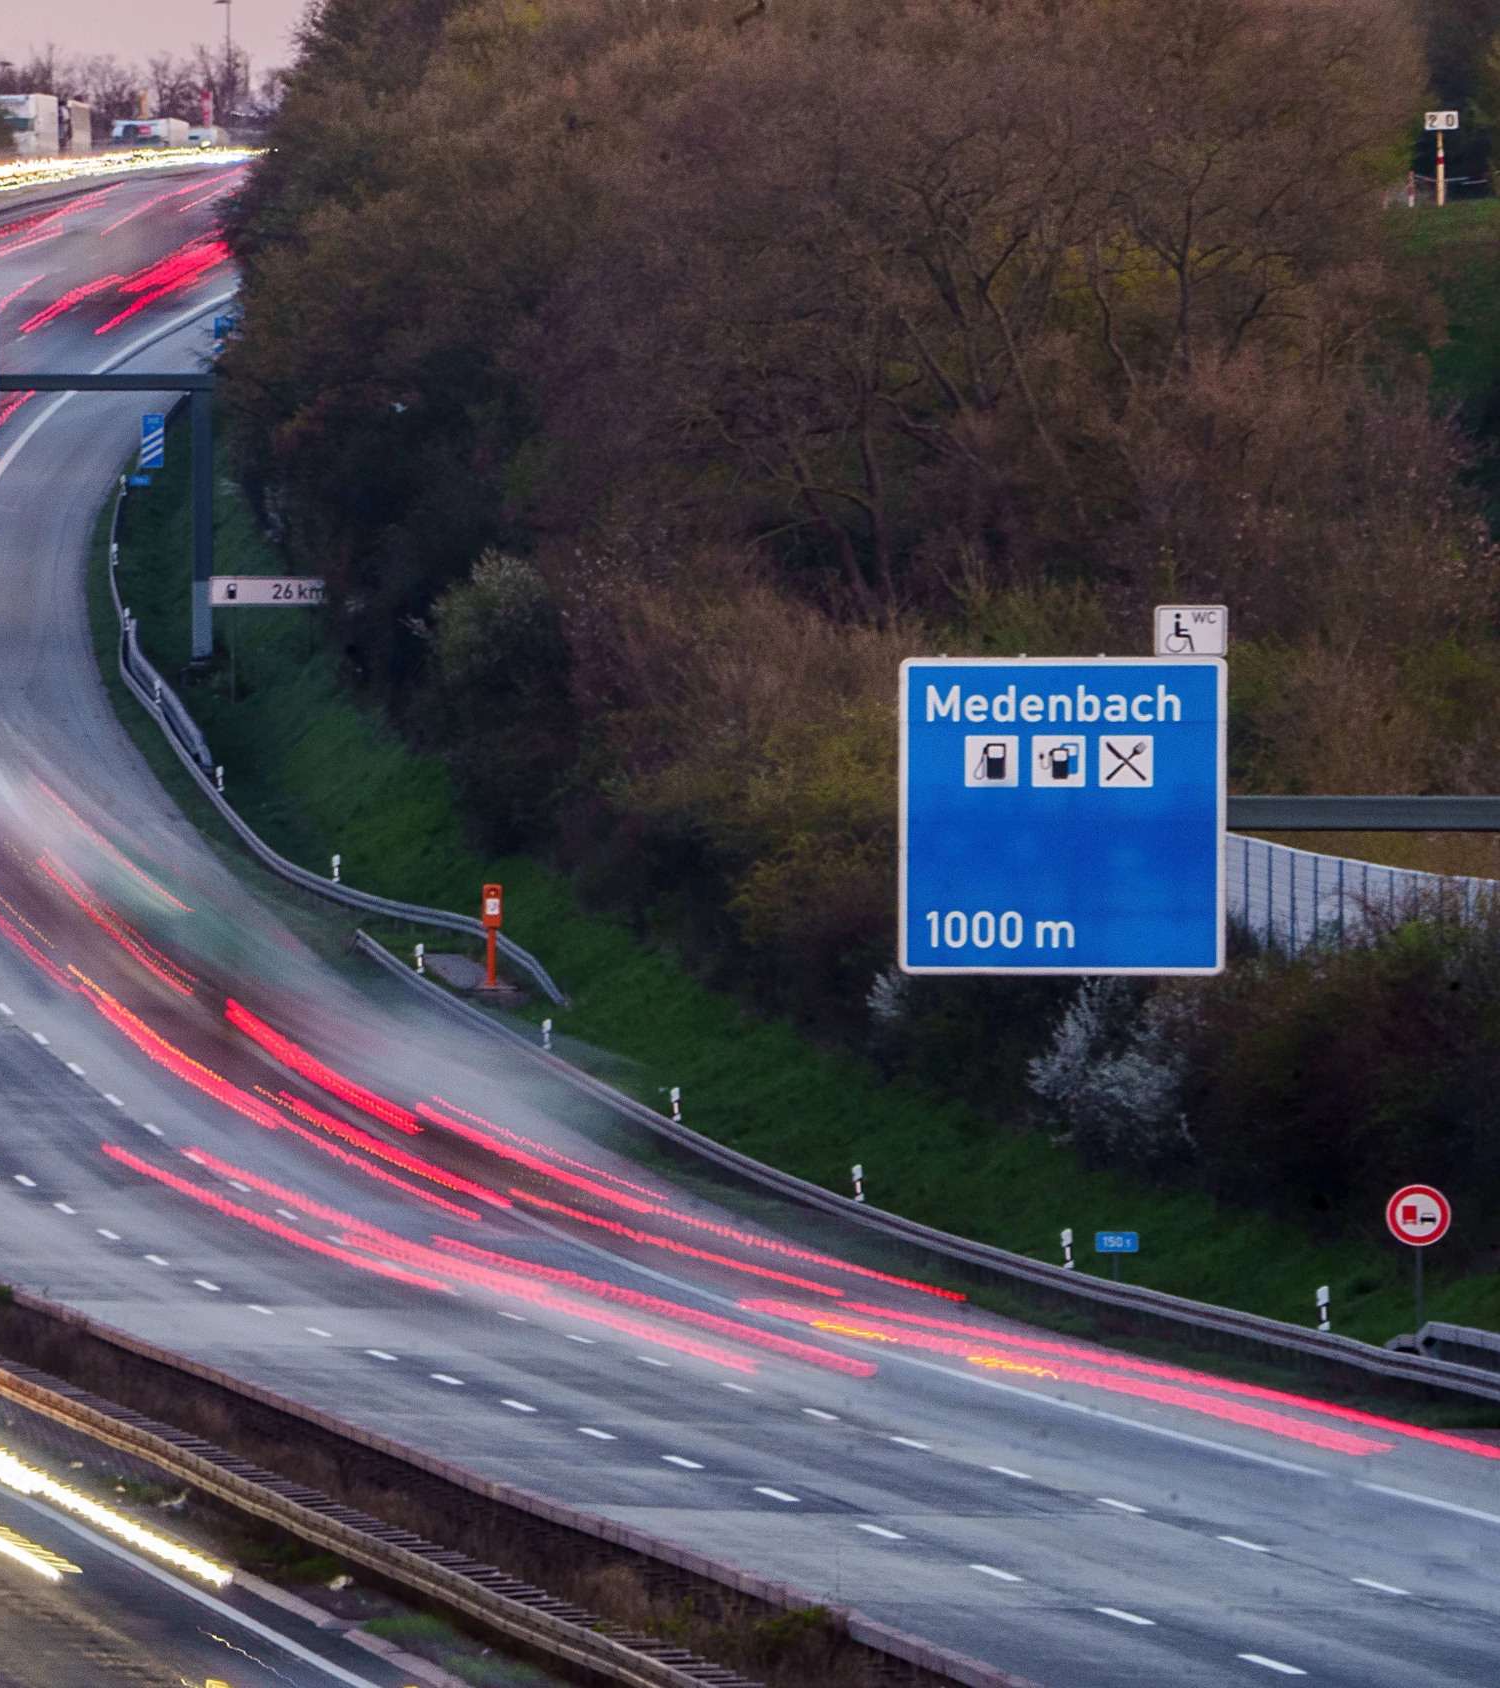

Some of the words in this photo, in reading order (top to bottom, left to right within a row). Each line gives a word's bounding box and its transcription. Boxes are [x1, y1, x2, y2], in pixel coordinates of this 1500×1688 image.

[272, 583, 294, 600] 26
[298, 583, 325, 600] km
[1192, 611, 1217, 624] WC
[925, 685, 1182, 722] Medenbach
[925, 911, 1023, 949] 1000
[1035, 919, 1075, 948] m
